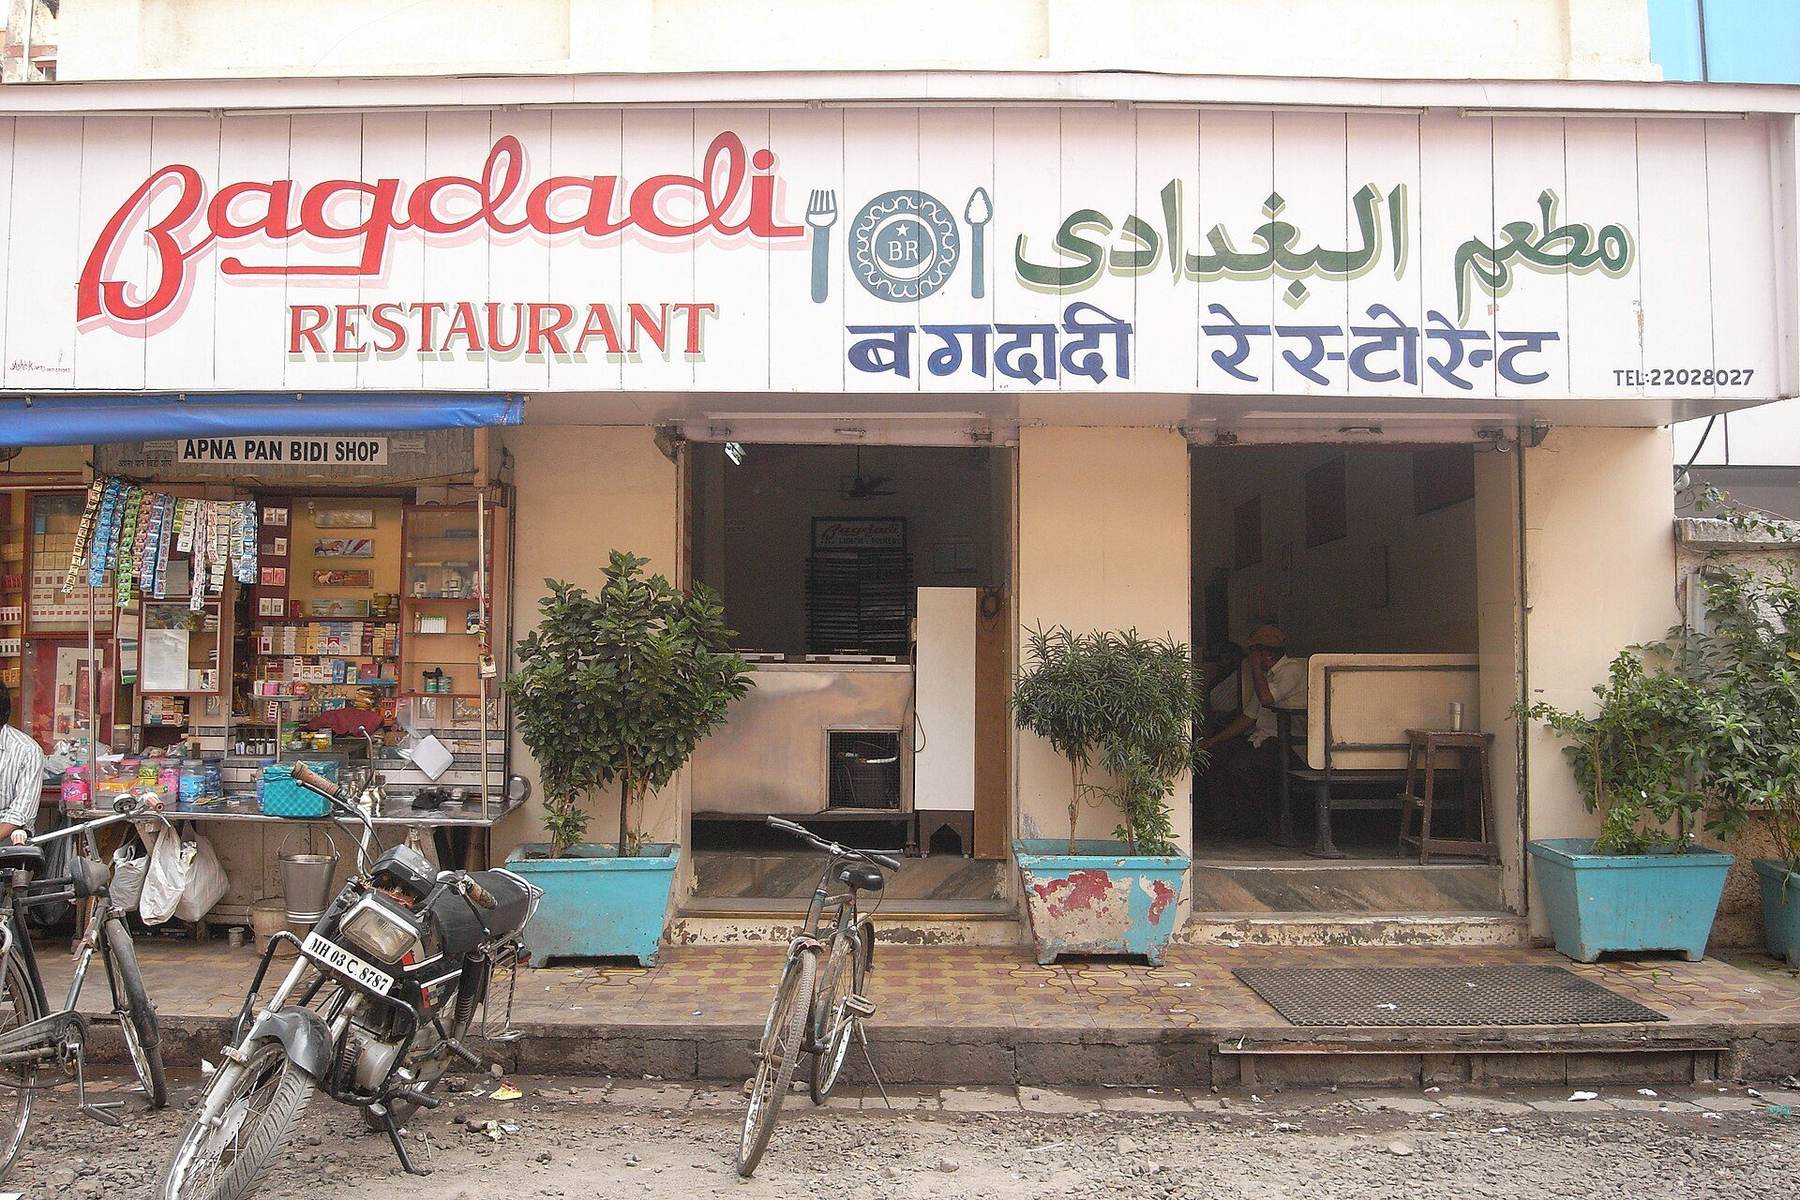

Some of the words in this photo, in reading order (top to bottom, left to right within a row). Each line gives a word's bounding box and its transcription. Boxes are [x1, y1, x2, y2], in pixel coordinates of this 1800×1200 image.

[76, 131, 805, 324] Bagdadi
[888, 240, 919, 261] BR
[1454, 188, 1634, 324] مطعم
[288, 302, 717, 358] RESTAURANT
[845, 301, 1133, 385] बगदादी
[1613, 368, 1755, 387] TEL:22028027
[183, 438, 237, 460] APNA
[244, 440, 283, 461] PAN
[290, 441, 329, 462] BIDI
[334, 440, 380, 462] SHOP
[308, 937, 331, 958] MH
[330, 950, 347, 967] 03
[358, 967, 389, 991] 8787
